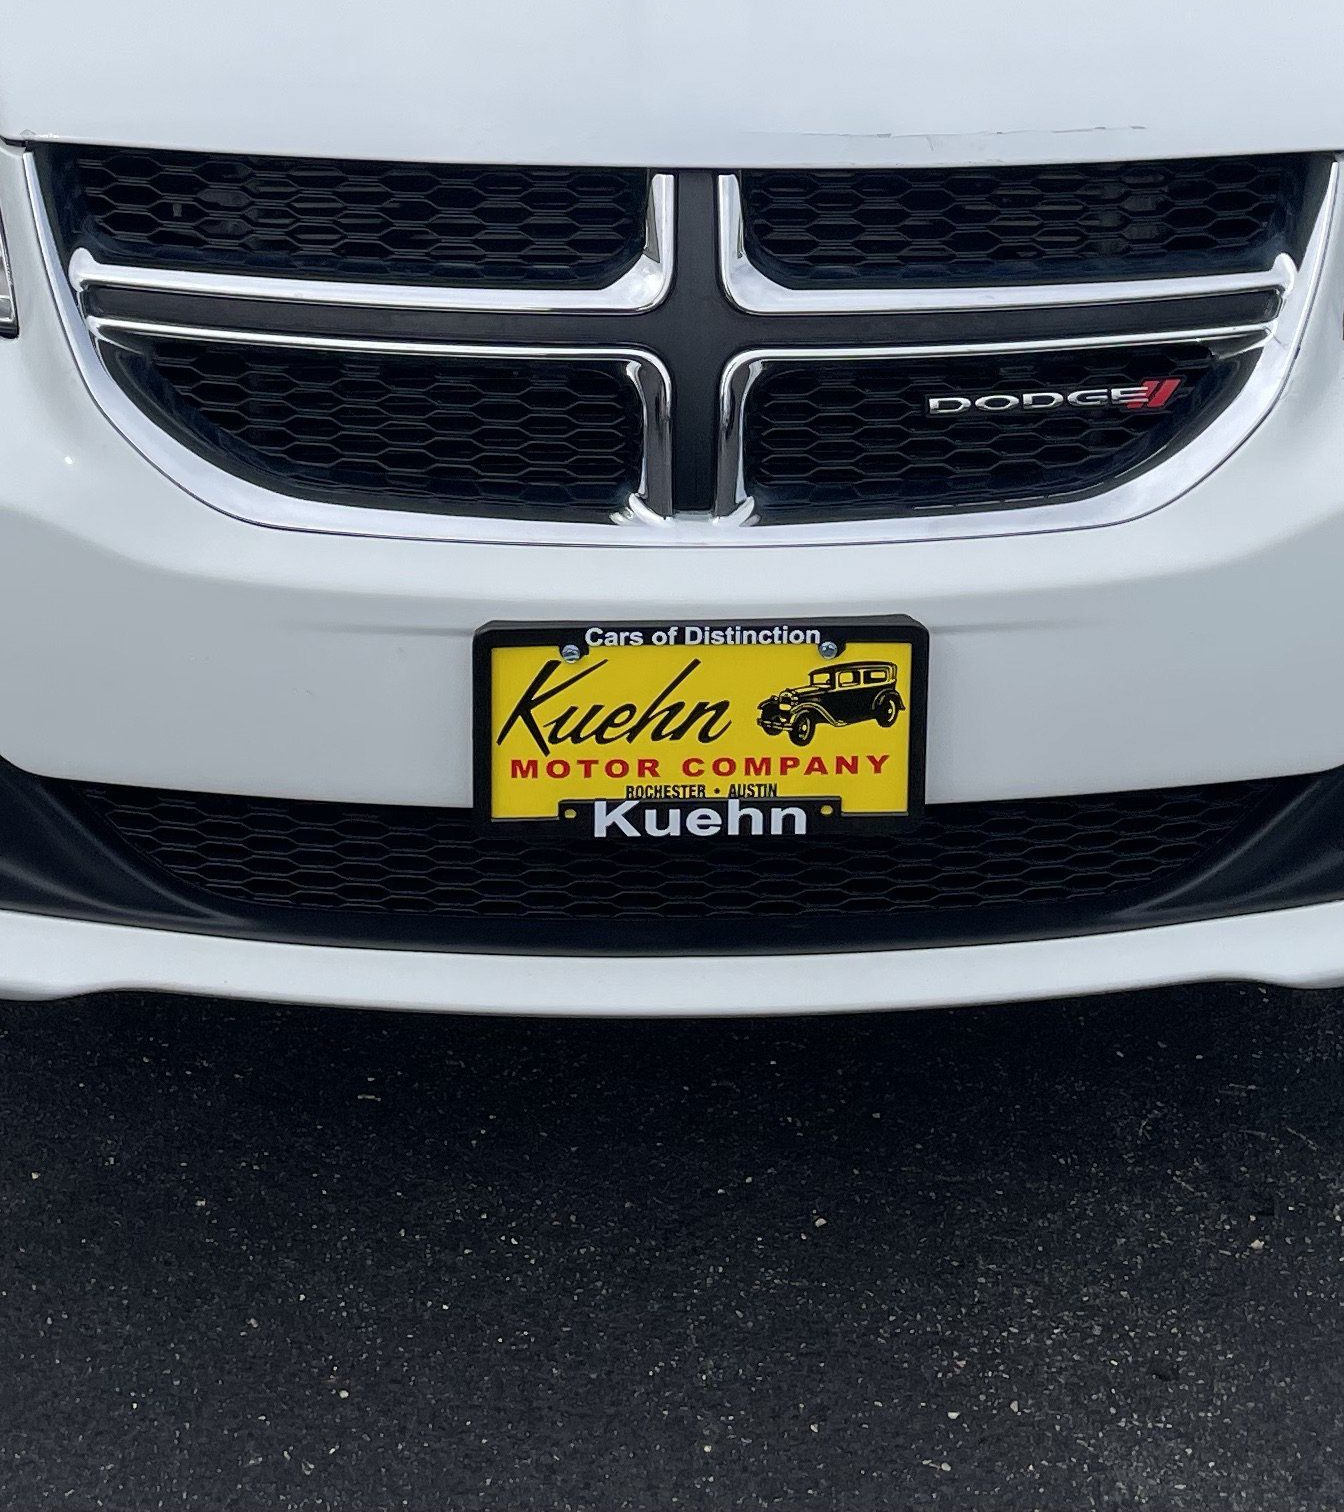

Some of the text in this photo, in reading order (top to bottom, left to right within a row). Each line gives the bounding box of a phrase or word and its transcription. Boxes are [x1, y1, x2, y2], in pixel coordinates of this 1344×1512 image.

[928, 386, 1149, 414] DODGE
[585, 625, 821, 647] Cars of Distinction
[496, 658, 733, 757] Kuehn
[510, 754, 891, 779] MOTOR COMPANY
[625, 783, 778, 800] ROCHESTER AUSTIN
[593, 800, 807, 838] Kuehn
